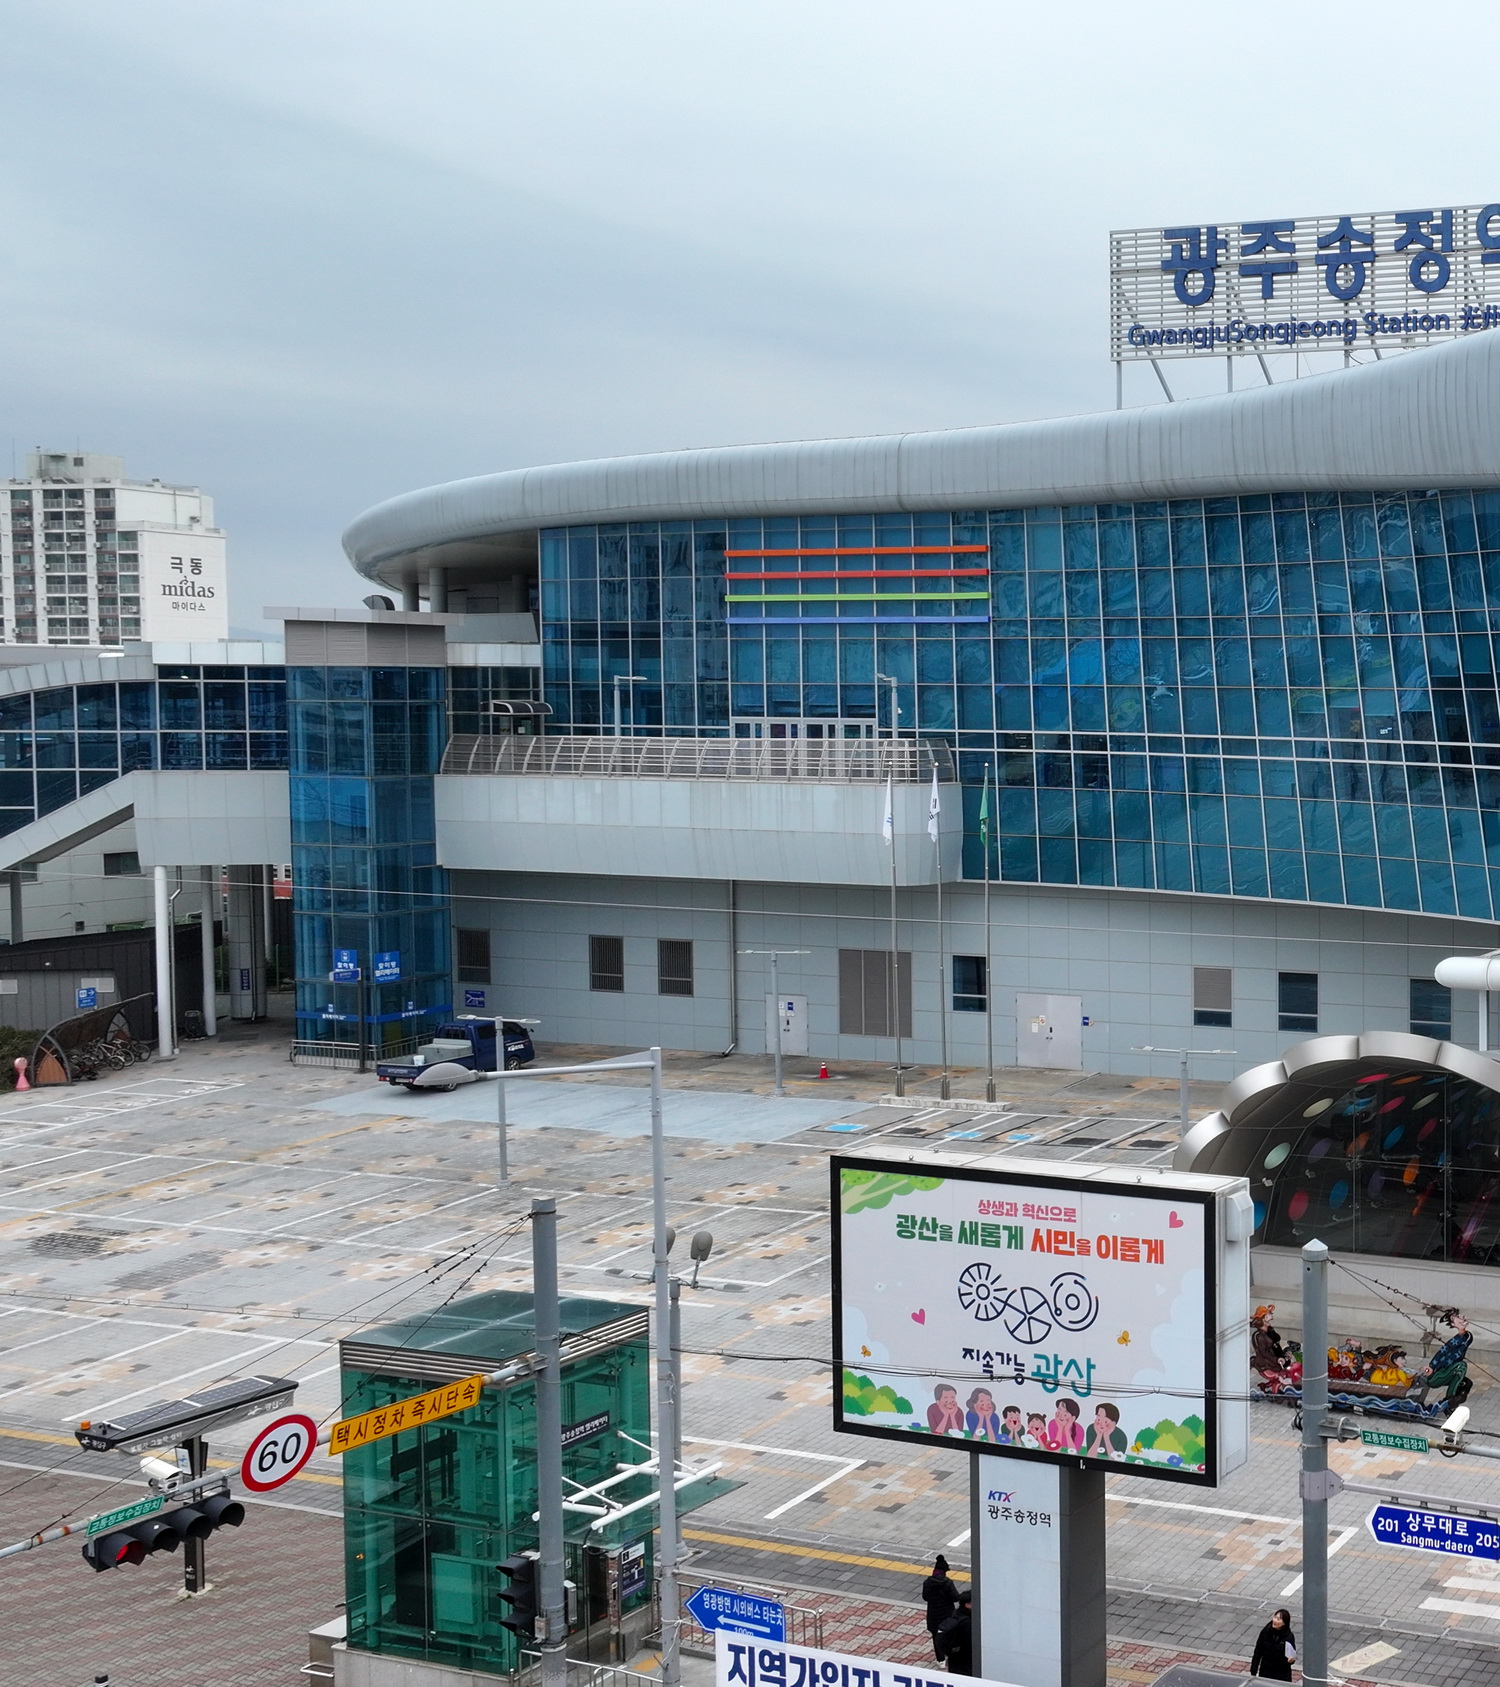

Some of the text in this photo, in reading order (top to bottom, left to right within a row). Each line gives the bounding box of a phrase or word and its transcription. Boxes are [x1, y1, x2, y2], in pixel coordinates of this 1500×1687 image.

[1127, 309, 1451, 349] GwangjuSongjeong Station
[170, 556, 203, 575] 극동
[161, 575, 215, 598] midas
[172, 601, 206, 612] 마이다스
[977, 1199, 1077, 1223] 상생과 혁신으로
[896, 1213, 1165, 1264] 광산을 새롭게 시민을 이롭게
[962, 1347, 1096, 1397] 지속가능 광산
[336, 1380, 476, 1444] 택시정차 즉시단속
[258, 1433, 301, 1472] 60
[1364, 1432, 1426, 1451] 교통정보수집장치
[988, 1491, 1013, 1503] KTX
[90, 1499, 163, 1534] 교통정보수집장치
[987, 1505, 1052, 1528] 광주송정역
[1377, 1513, 1500, 1549] 201 상무대로 205
[1401, 1532, 1474, 1554] Sangmu-daero
[702, 1592, 783, 1626] 영광방면 시외버스 타는곳
